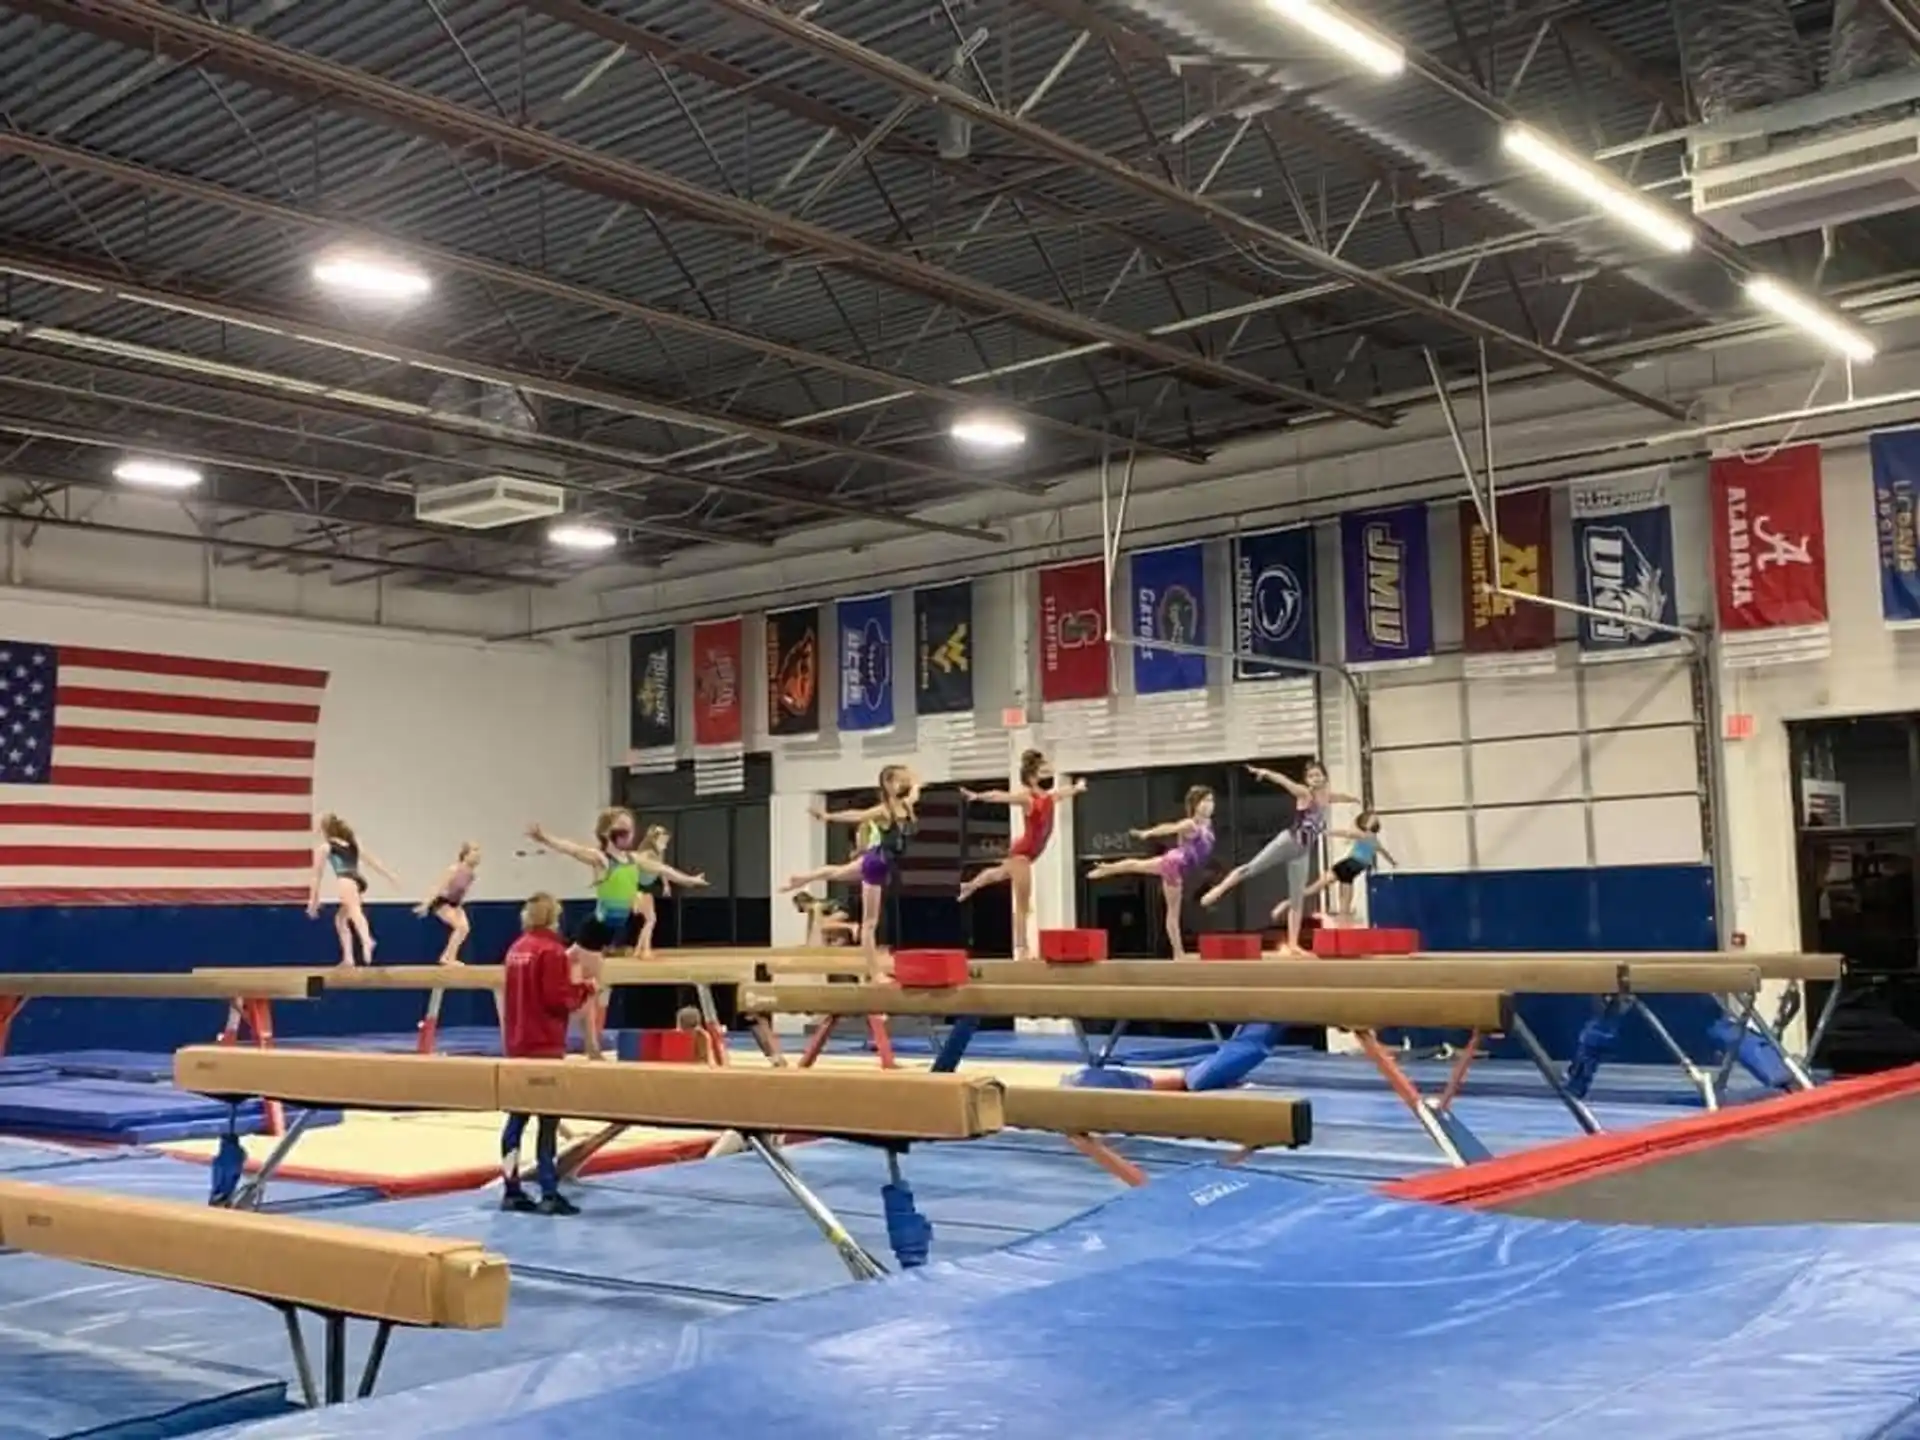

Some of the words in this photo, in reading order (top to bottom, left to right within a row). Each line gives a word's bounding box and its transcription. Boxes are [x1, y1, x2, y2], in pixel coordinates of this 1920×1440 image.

[1240, 557, 1252, 603] PENN
[1366, 526, 1402, 644] JMU
[1728, 487, 1754, 609] ALABAMA
[1044, 596, 1058, 672] STANFORD
